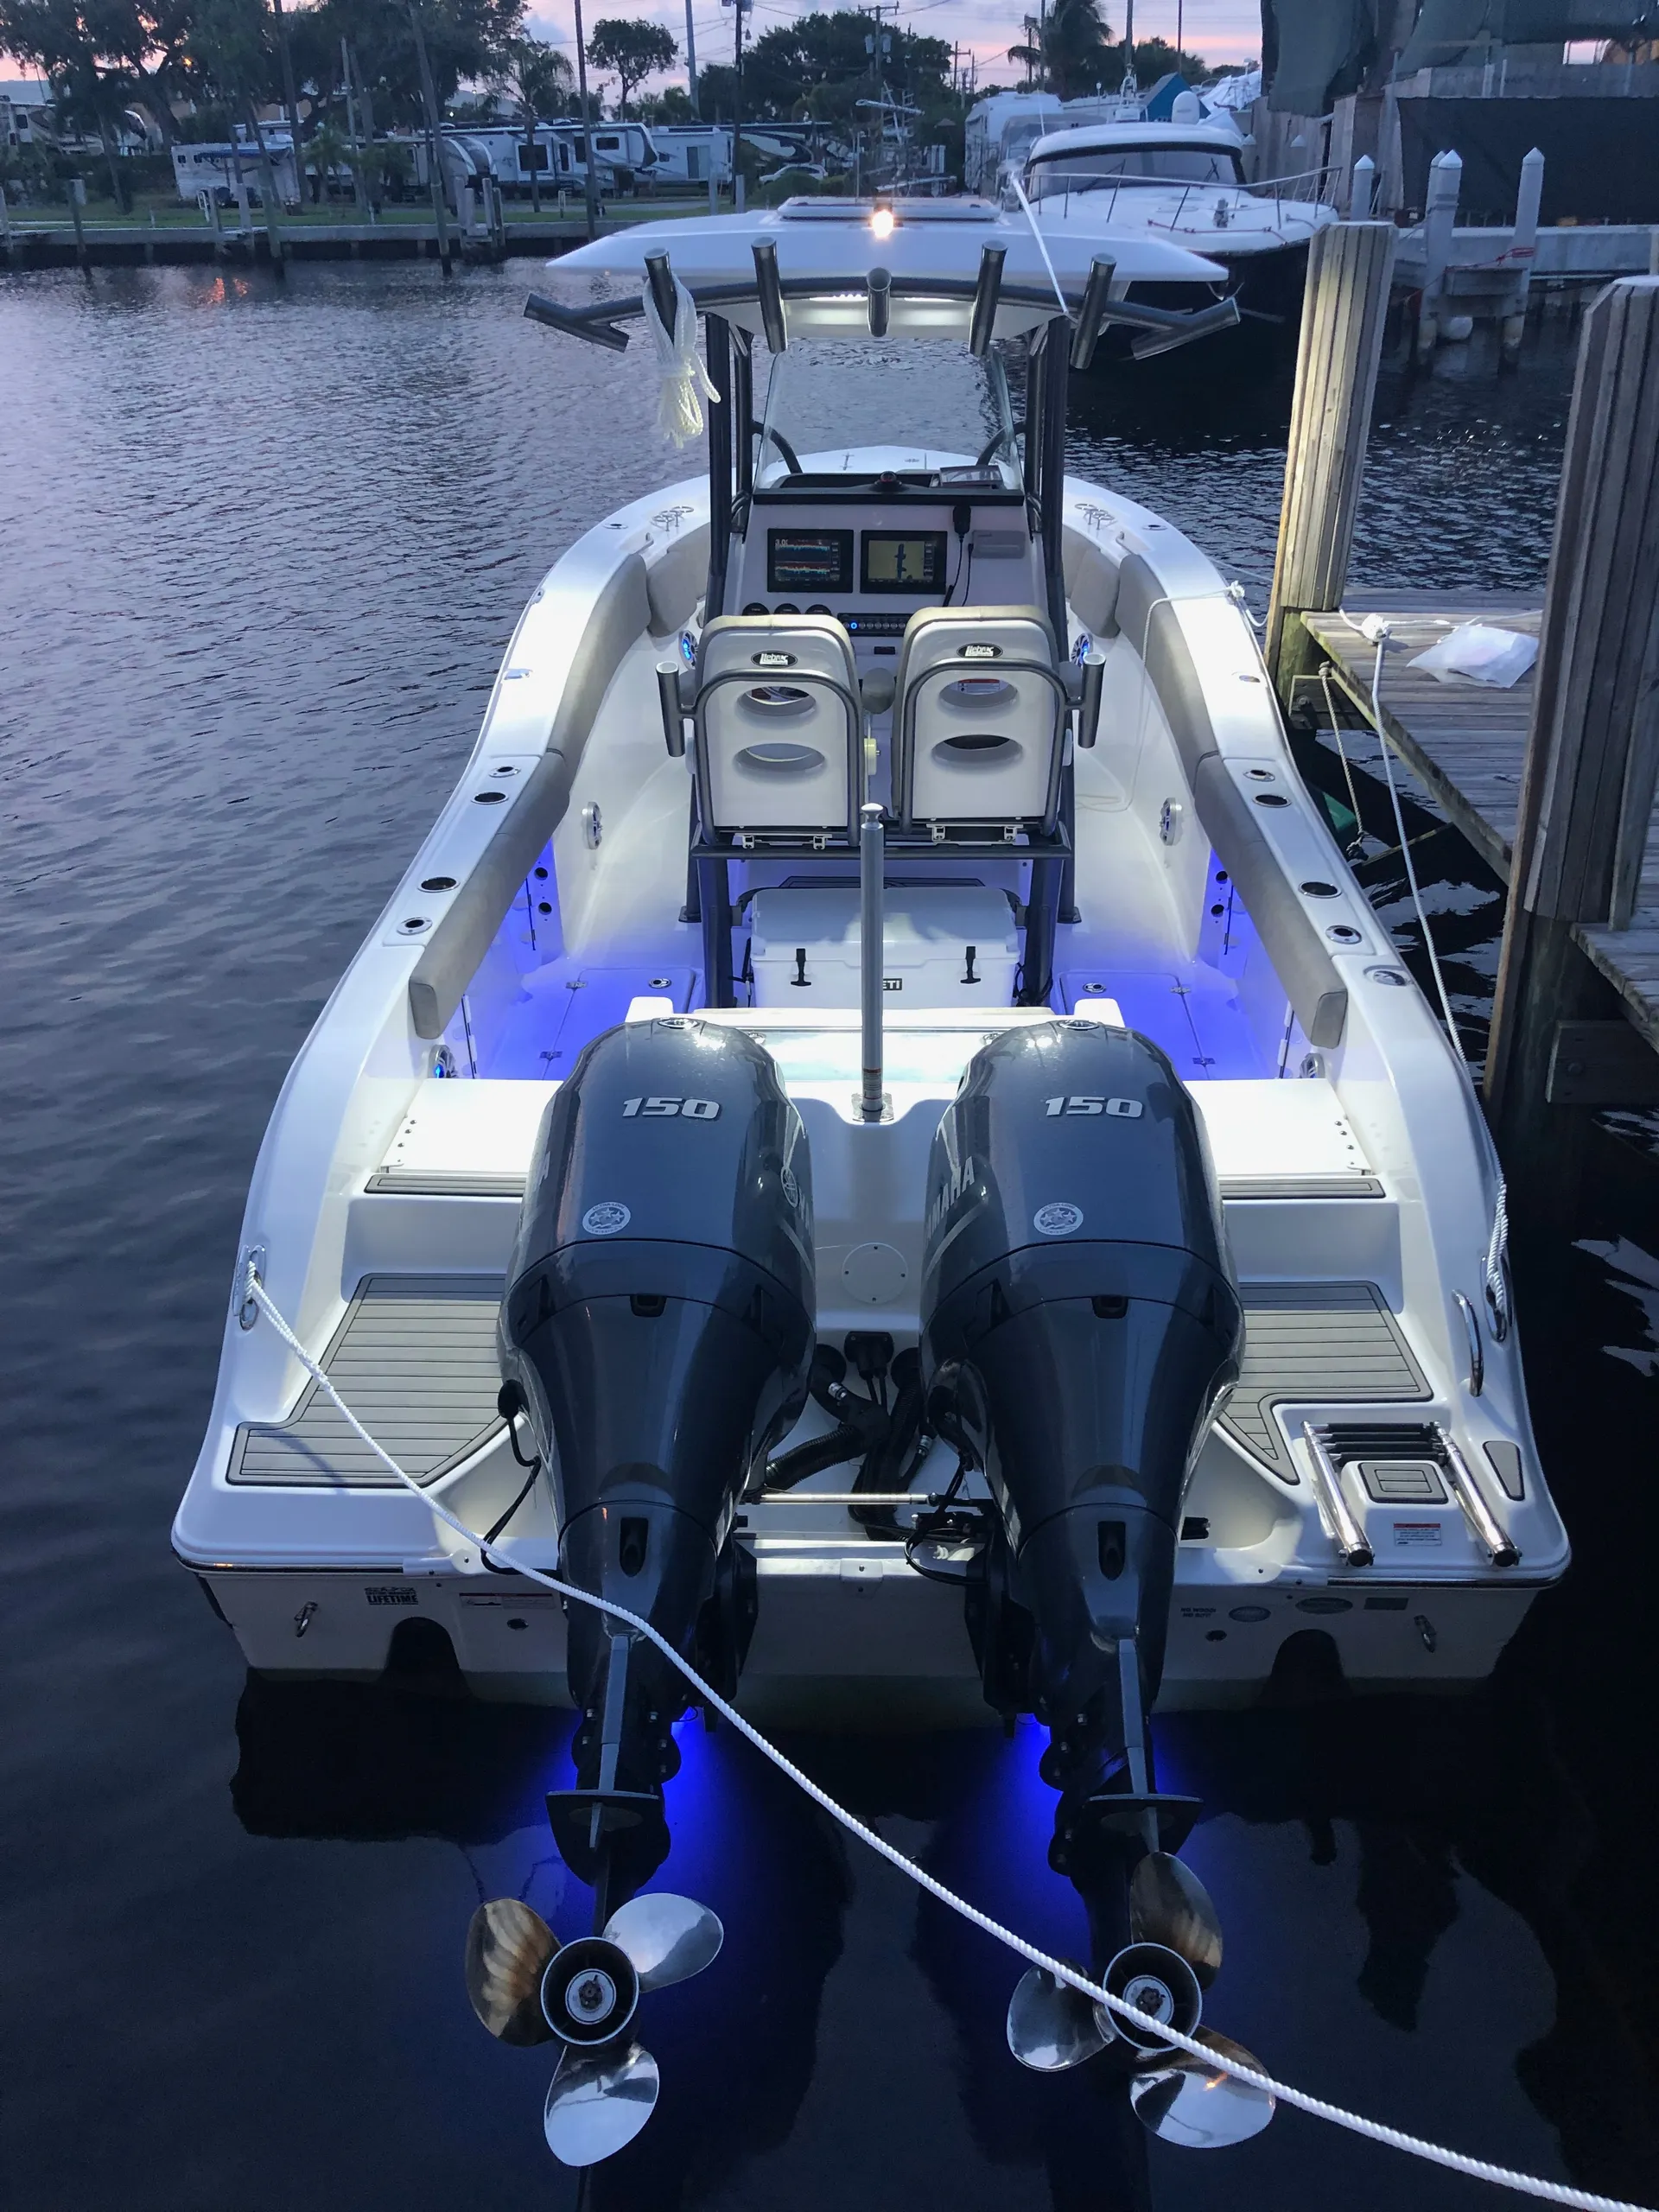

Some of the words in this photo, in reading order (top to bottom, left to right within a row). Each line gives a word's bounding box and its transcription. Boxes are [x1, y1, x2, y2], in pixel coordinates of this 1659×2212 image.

[882, 980, 900, 989] ETI
[622, 1096, 721, 1120] 150
[1045, 1096, 1143, 1119] 150
